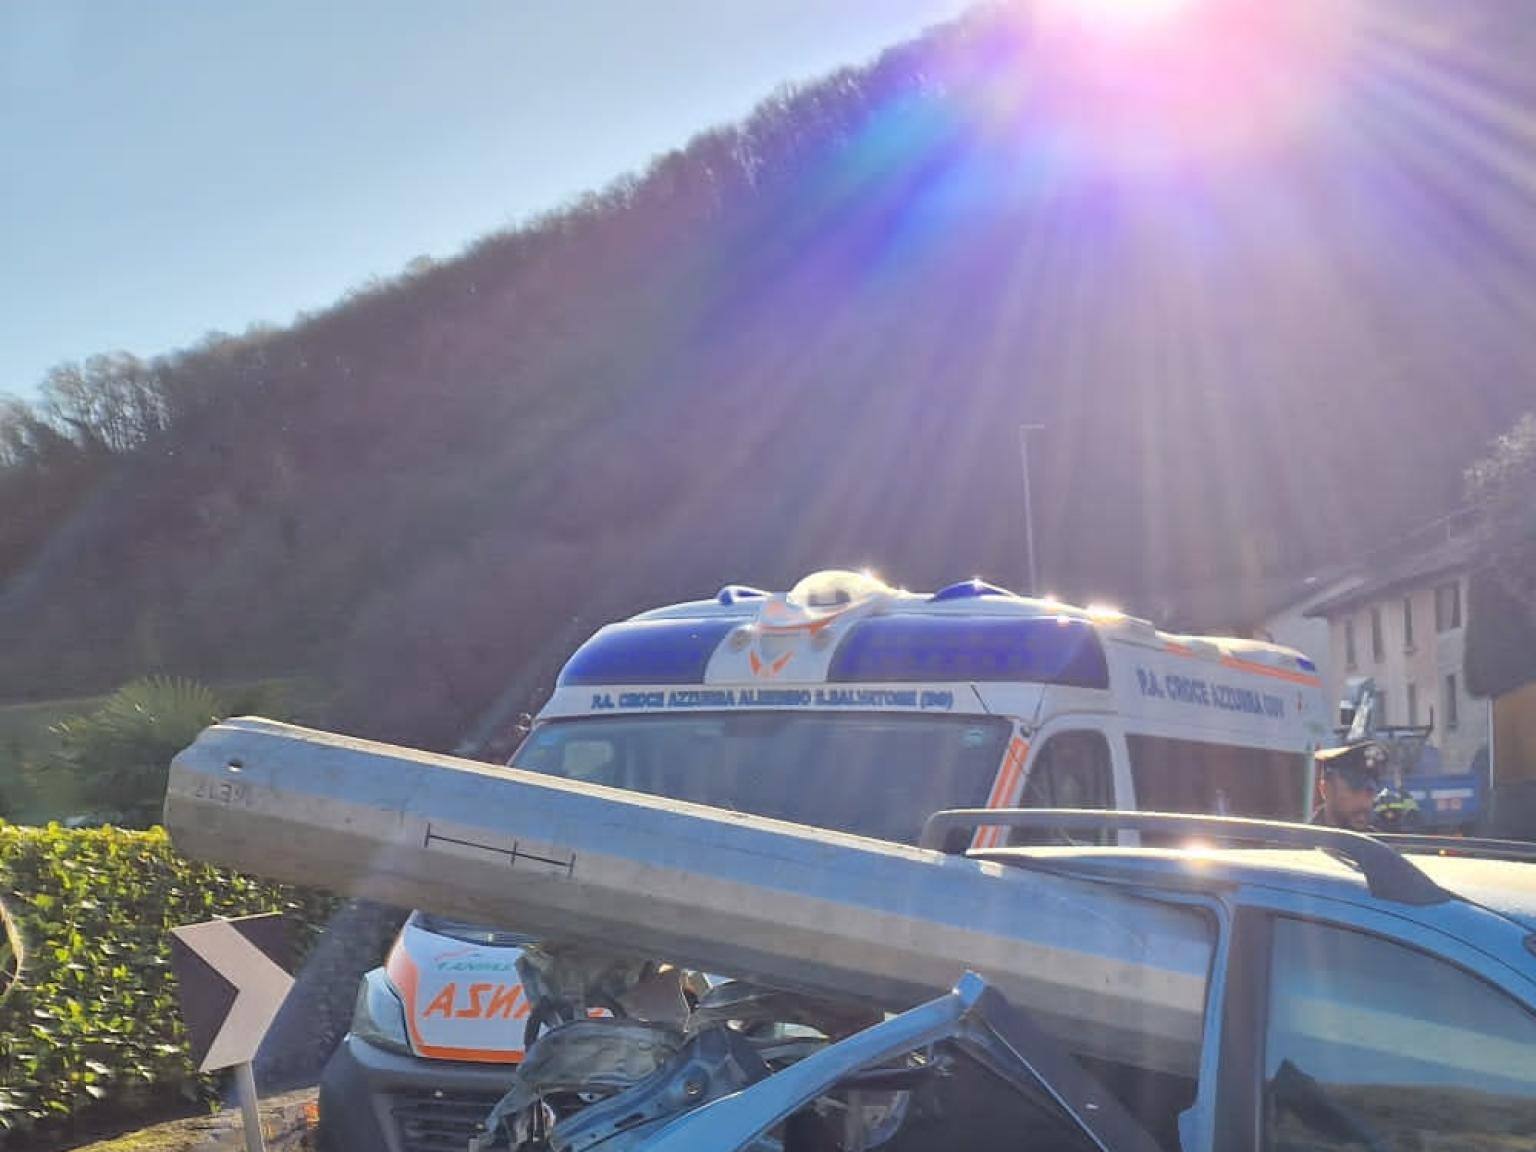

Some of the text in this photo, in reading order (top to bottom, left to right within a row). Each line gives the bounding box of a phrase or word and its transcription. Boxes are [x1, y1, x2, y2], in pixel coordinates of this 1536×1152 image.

[619, 692, 664, 708] CROCE
[667, 690, 735, 707] AZZURRA
[1165, 675, 1210, 706] CROCE
